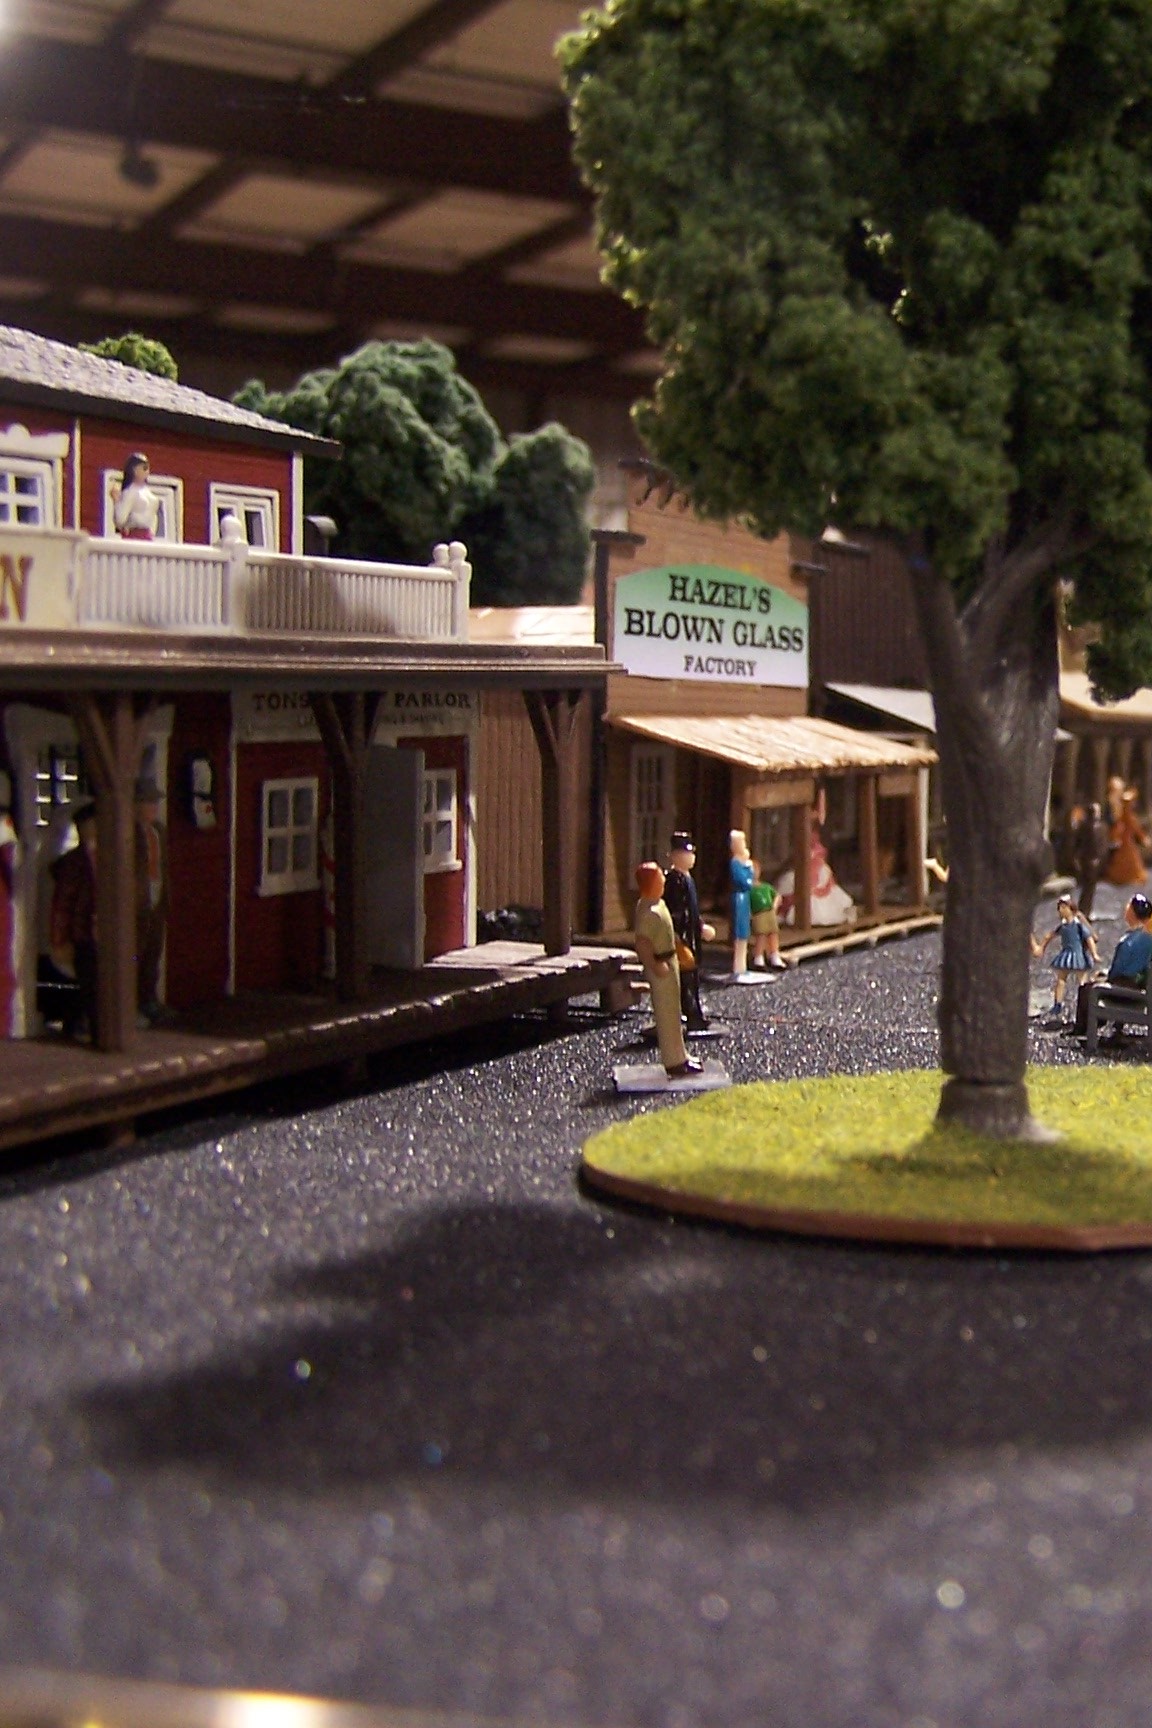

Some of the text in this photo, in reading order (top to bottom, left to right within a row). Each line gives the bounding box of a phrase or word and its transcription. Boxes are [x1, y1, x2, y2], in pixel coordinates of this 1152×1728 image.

[668, 573, 771, 614] HAZEL'S
[624, 607, 804, 652] BLOWN GLASS
[684, 655, 757, 677] FACTORY
[253, 692, 471, 710] TONS PARLOR
